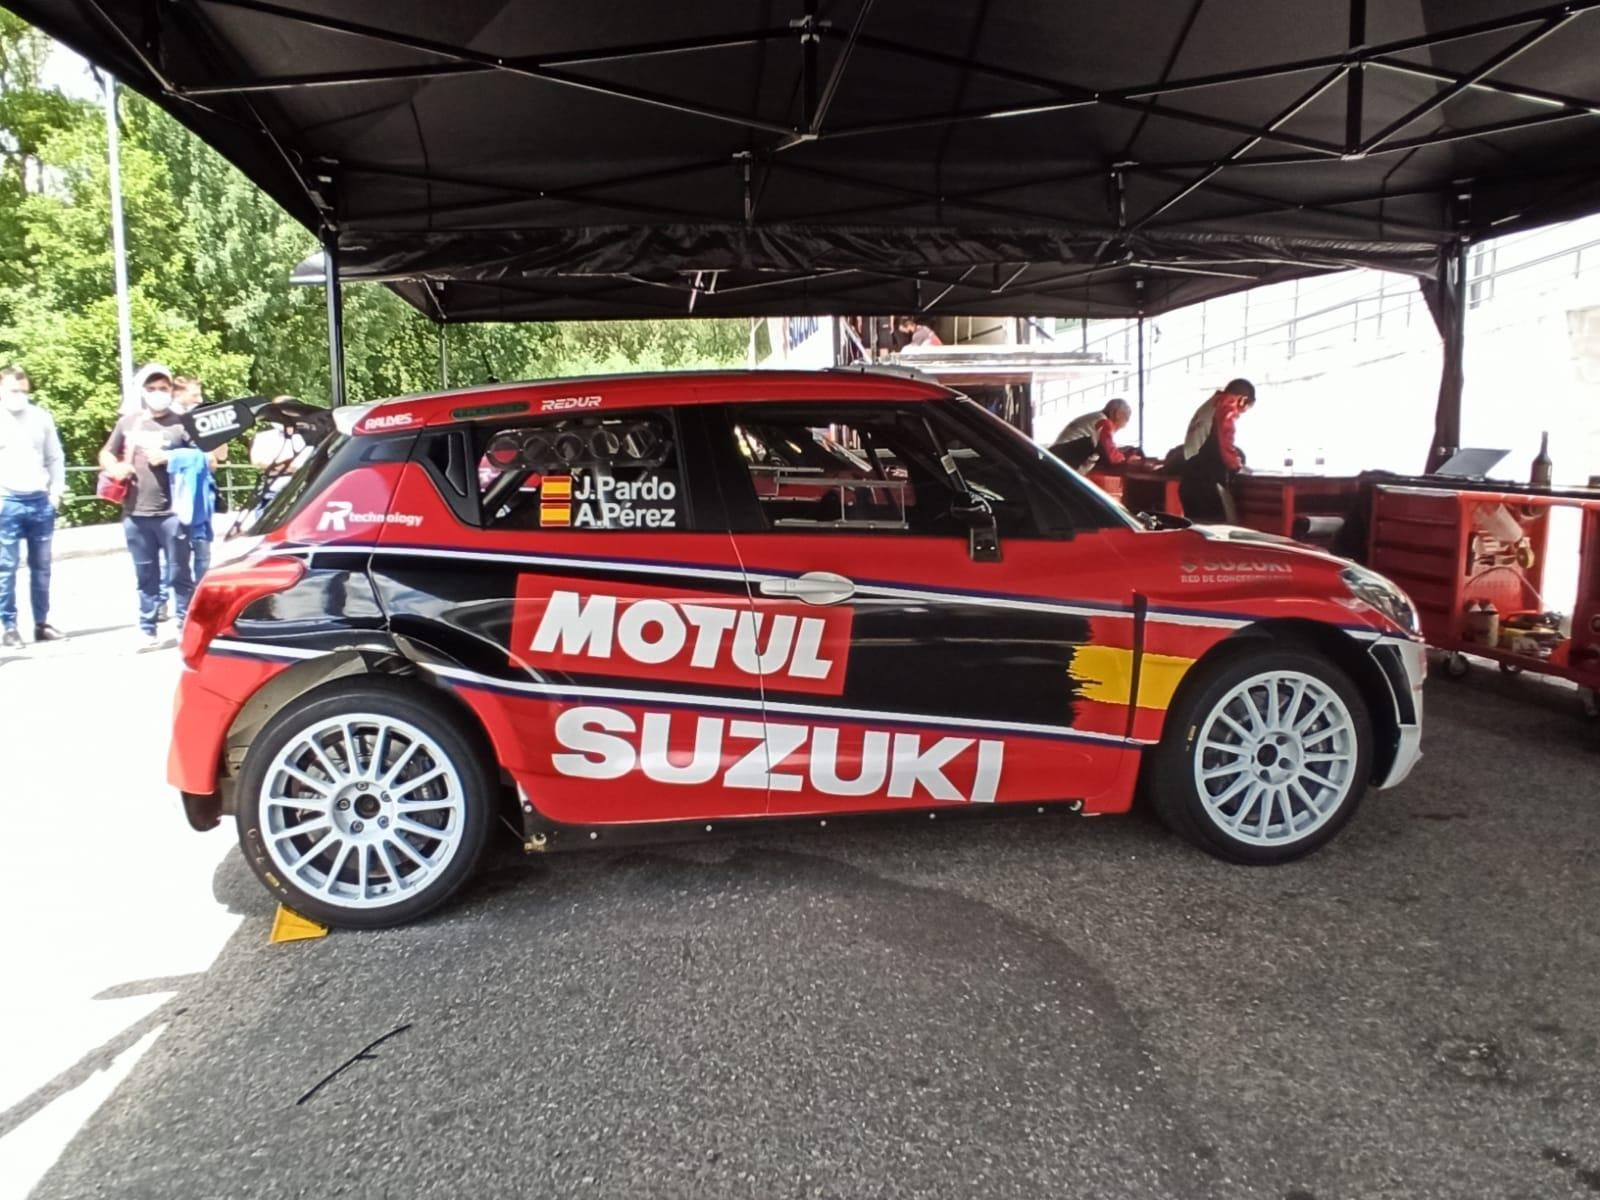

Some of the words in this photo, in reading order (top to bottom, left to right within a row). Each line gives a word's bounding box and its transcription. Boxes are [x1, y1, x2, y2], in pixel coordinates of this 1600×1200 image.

[541, 395, 602, 411] REDUR
[195, 407, 237, 432] OMP
[574, 476, 676, 500] J.Pardo
[574, 502, 676, 527] A.Pérez
[529, 590, 833, 680] MOTUL
[551, 706, 1004, 803] SUZUKI
